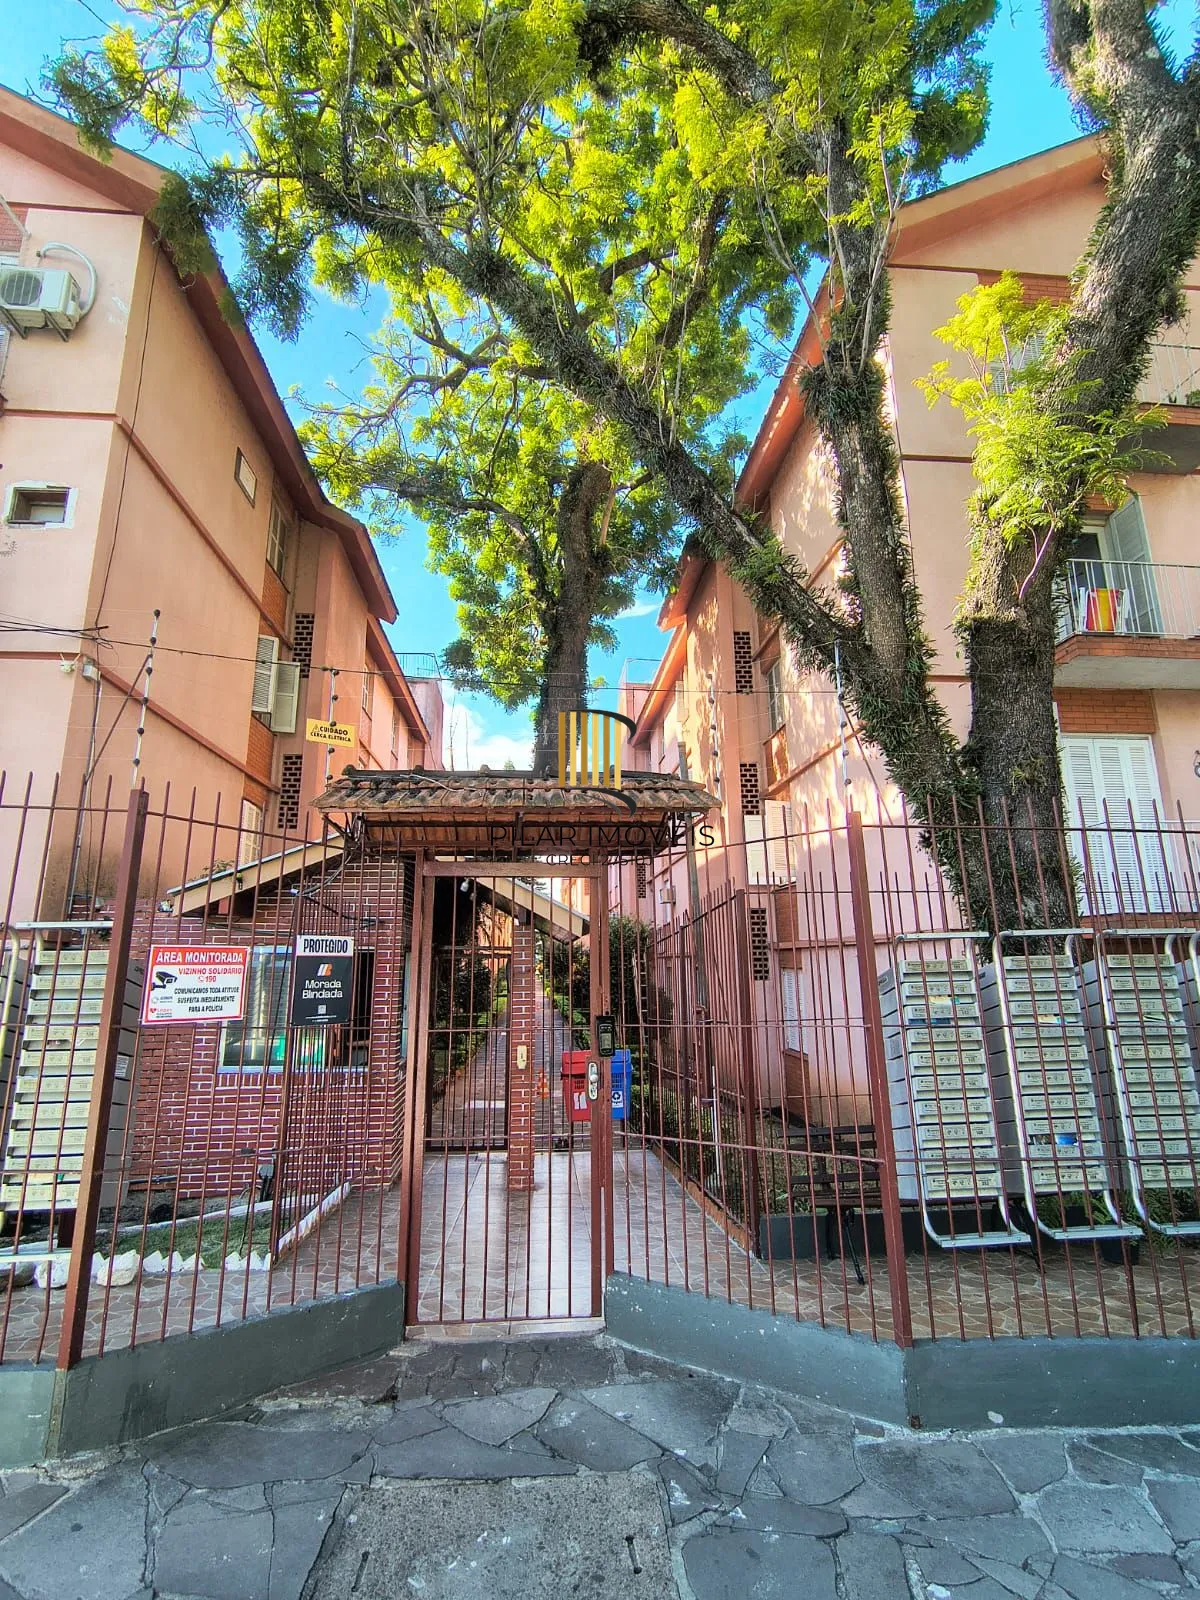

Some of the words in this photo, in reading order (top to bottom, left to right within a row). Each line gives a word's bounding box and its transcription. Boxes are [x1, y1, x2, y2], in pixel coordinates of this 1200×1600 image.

[310, 731, 327, 739] CERCA
[320, 726, 349, 736] CUIDADO
[303, 939, 348, 953] PROTEGIDO
[156, 949, 182, 962] ÁREA
[185, 952, 243, 963] MONITORADA
[178, 967, 206, 975] VIZINHO
[205, 975, 217, 983] 190
[305, 980, 342, 989] Morada
[302, 989, 343, 999] Blindada
[200, 995, 235, 1003] IMEDIATAMENTE
